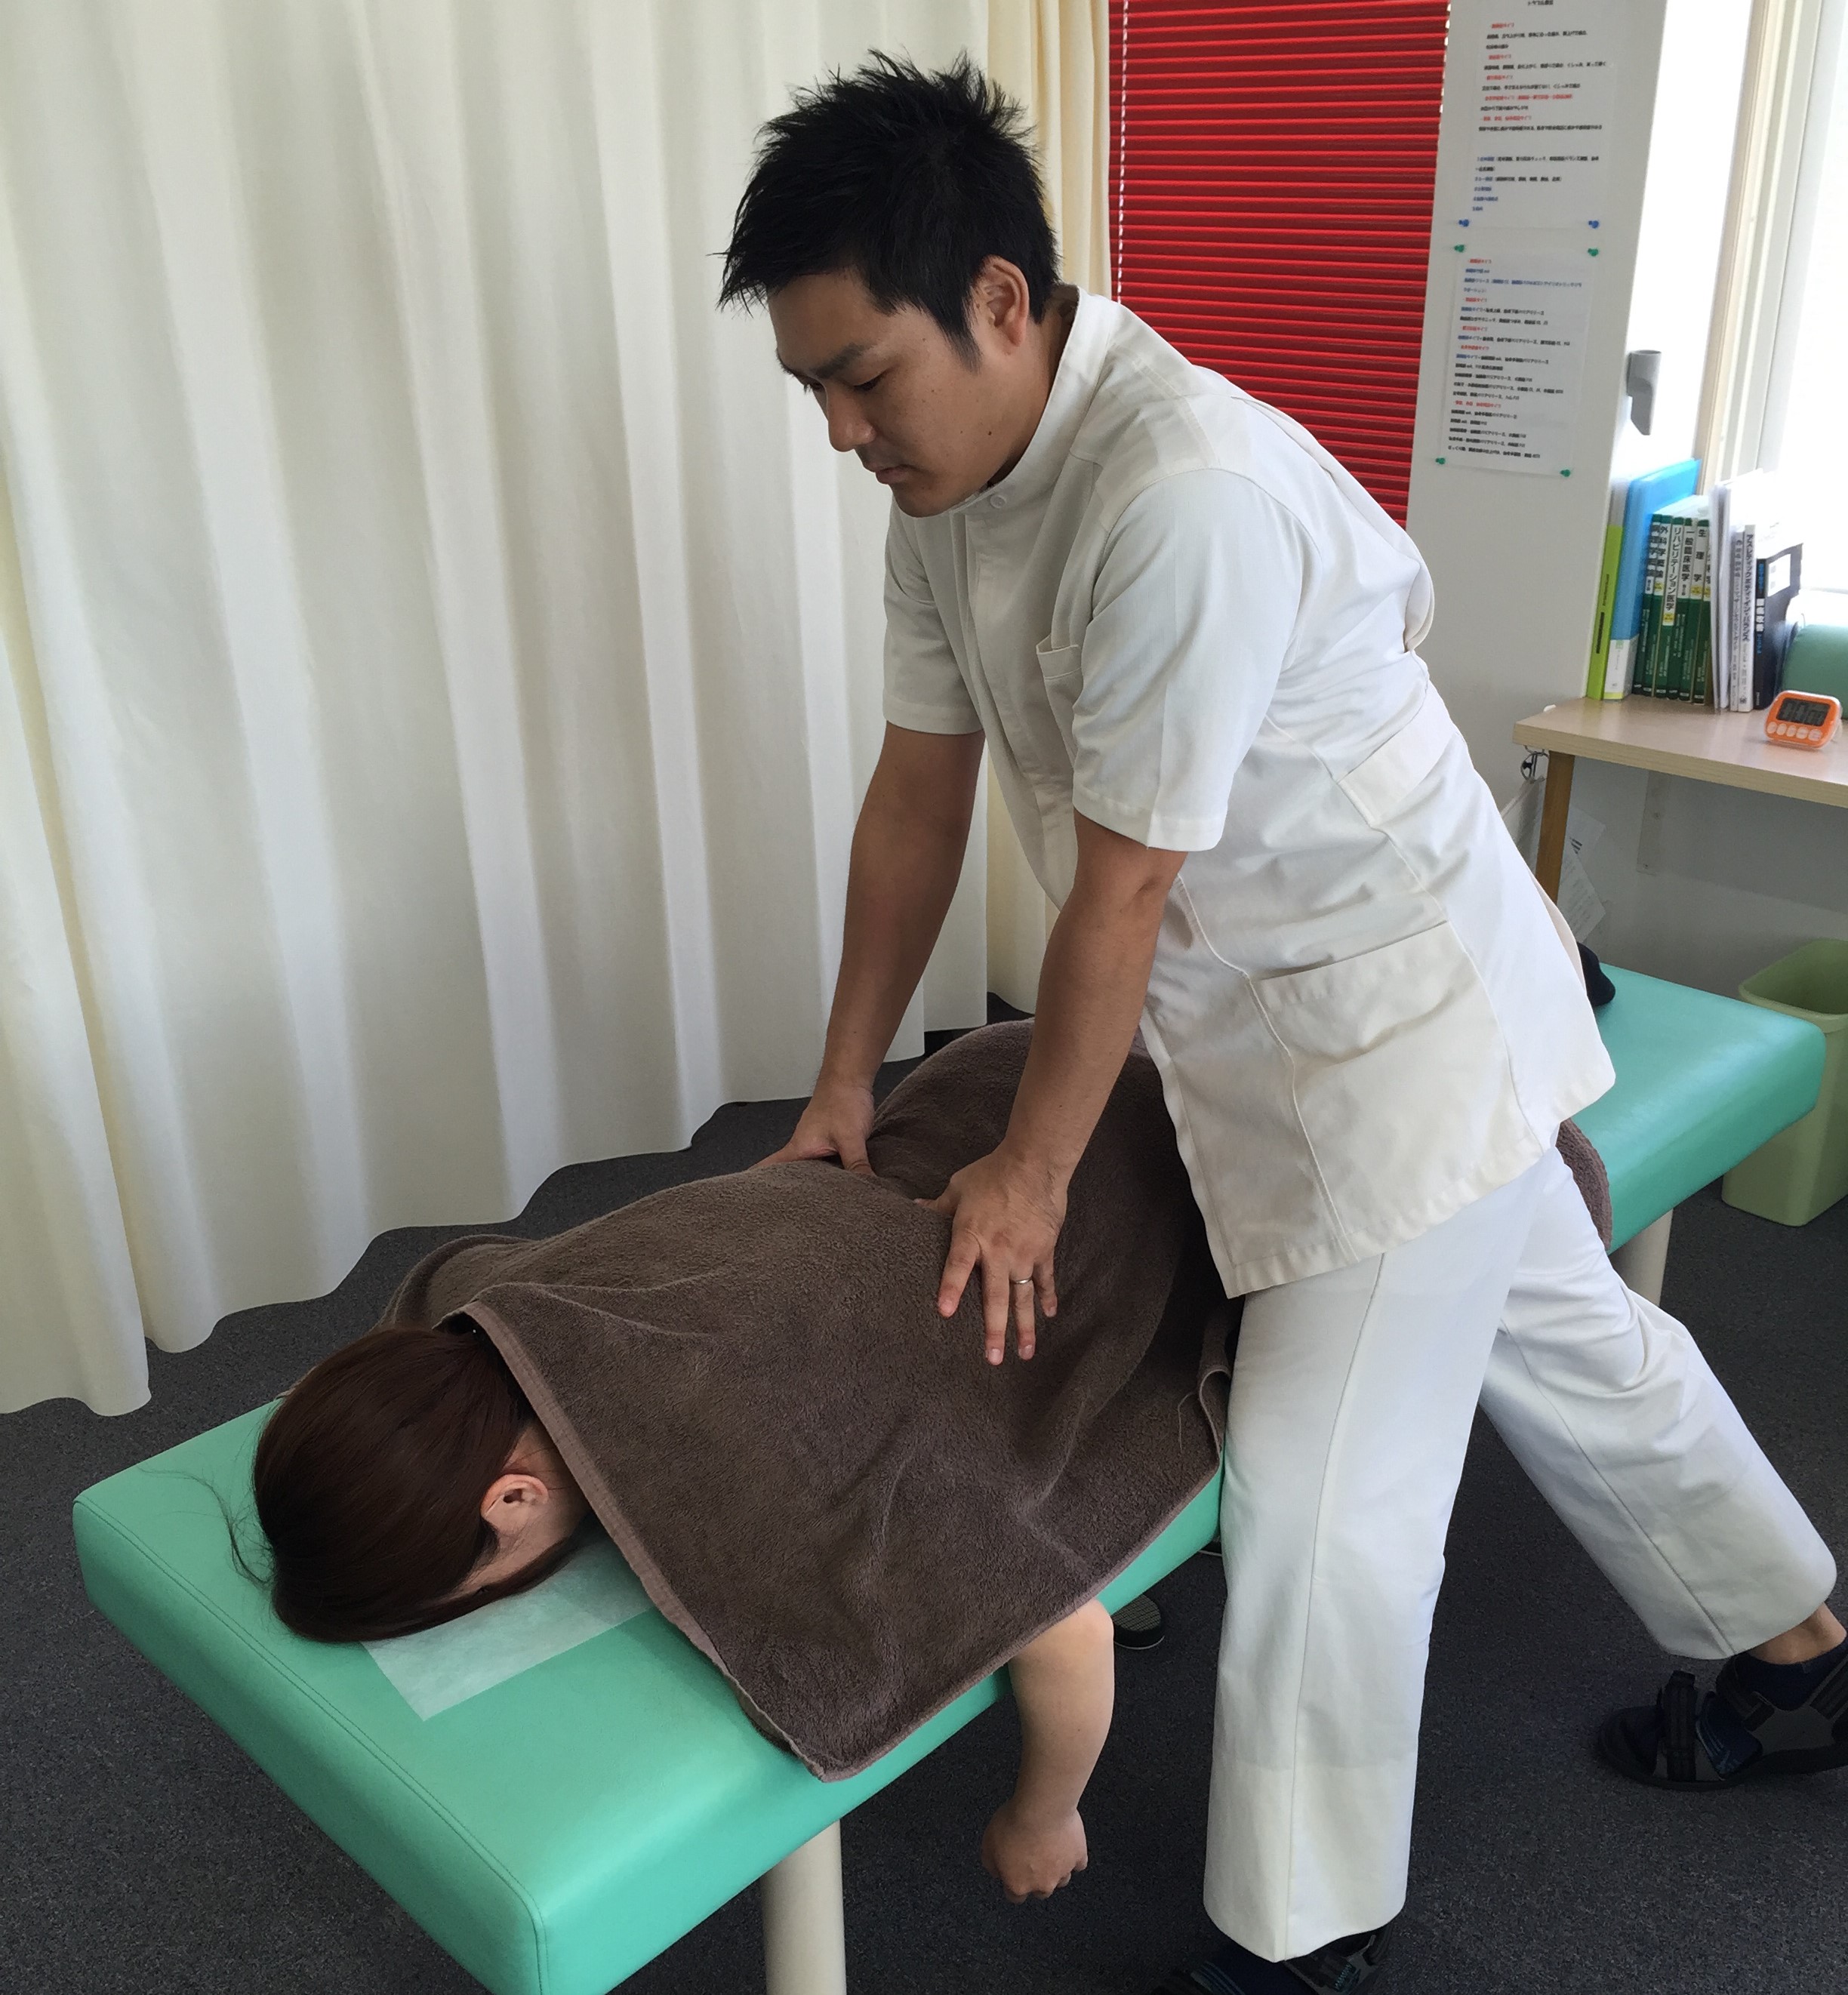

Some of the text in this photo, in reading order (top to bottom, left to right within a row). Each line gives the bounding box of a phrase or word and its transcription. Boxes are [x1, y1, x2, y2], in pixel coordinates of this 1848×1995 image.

[1666, 527, 1682, 611] リハビリテーション医学
[1693, 529, 1707, 582] 生理学
